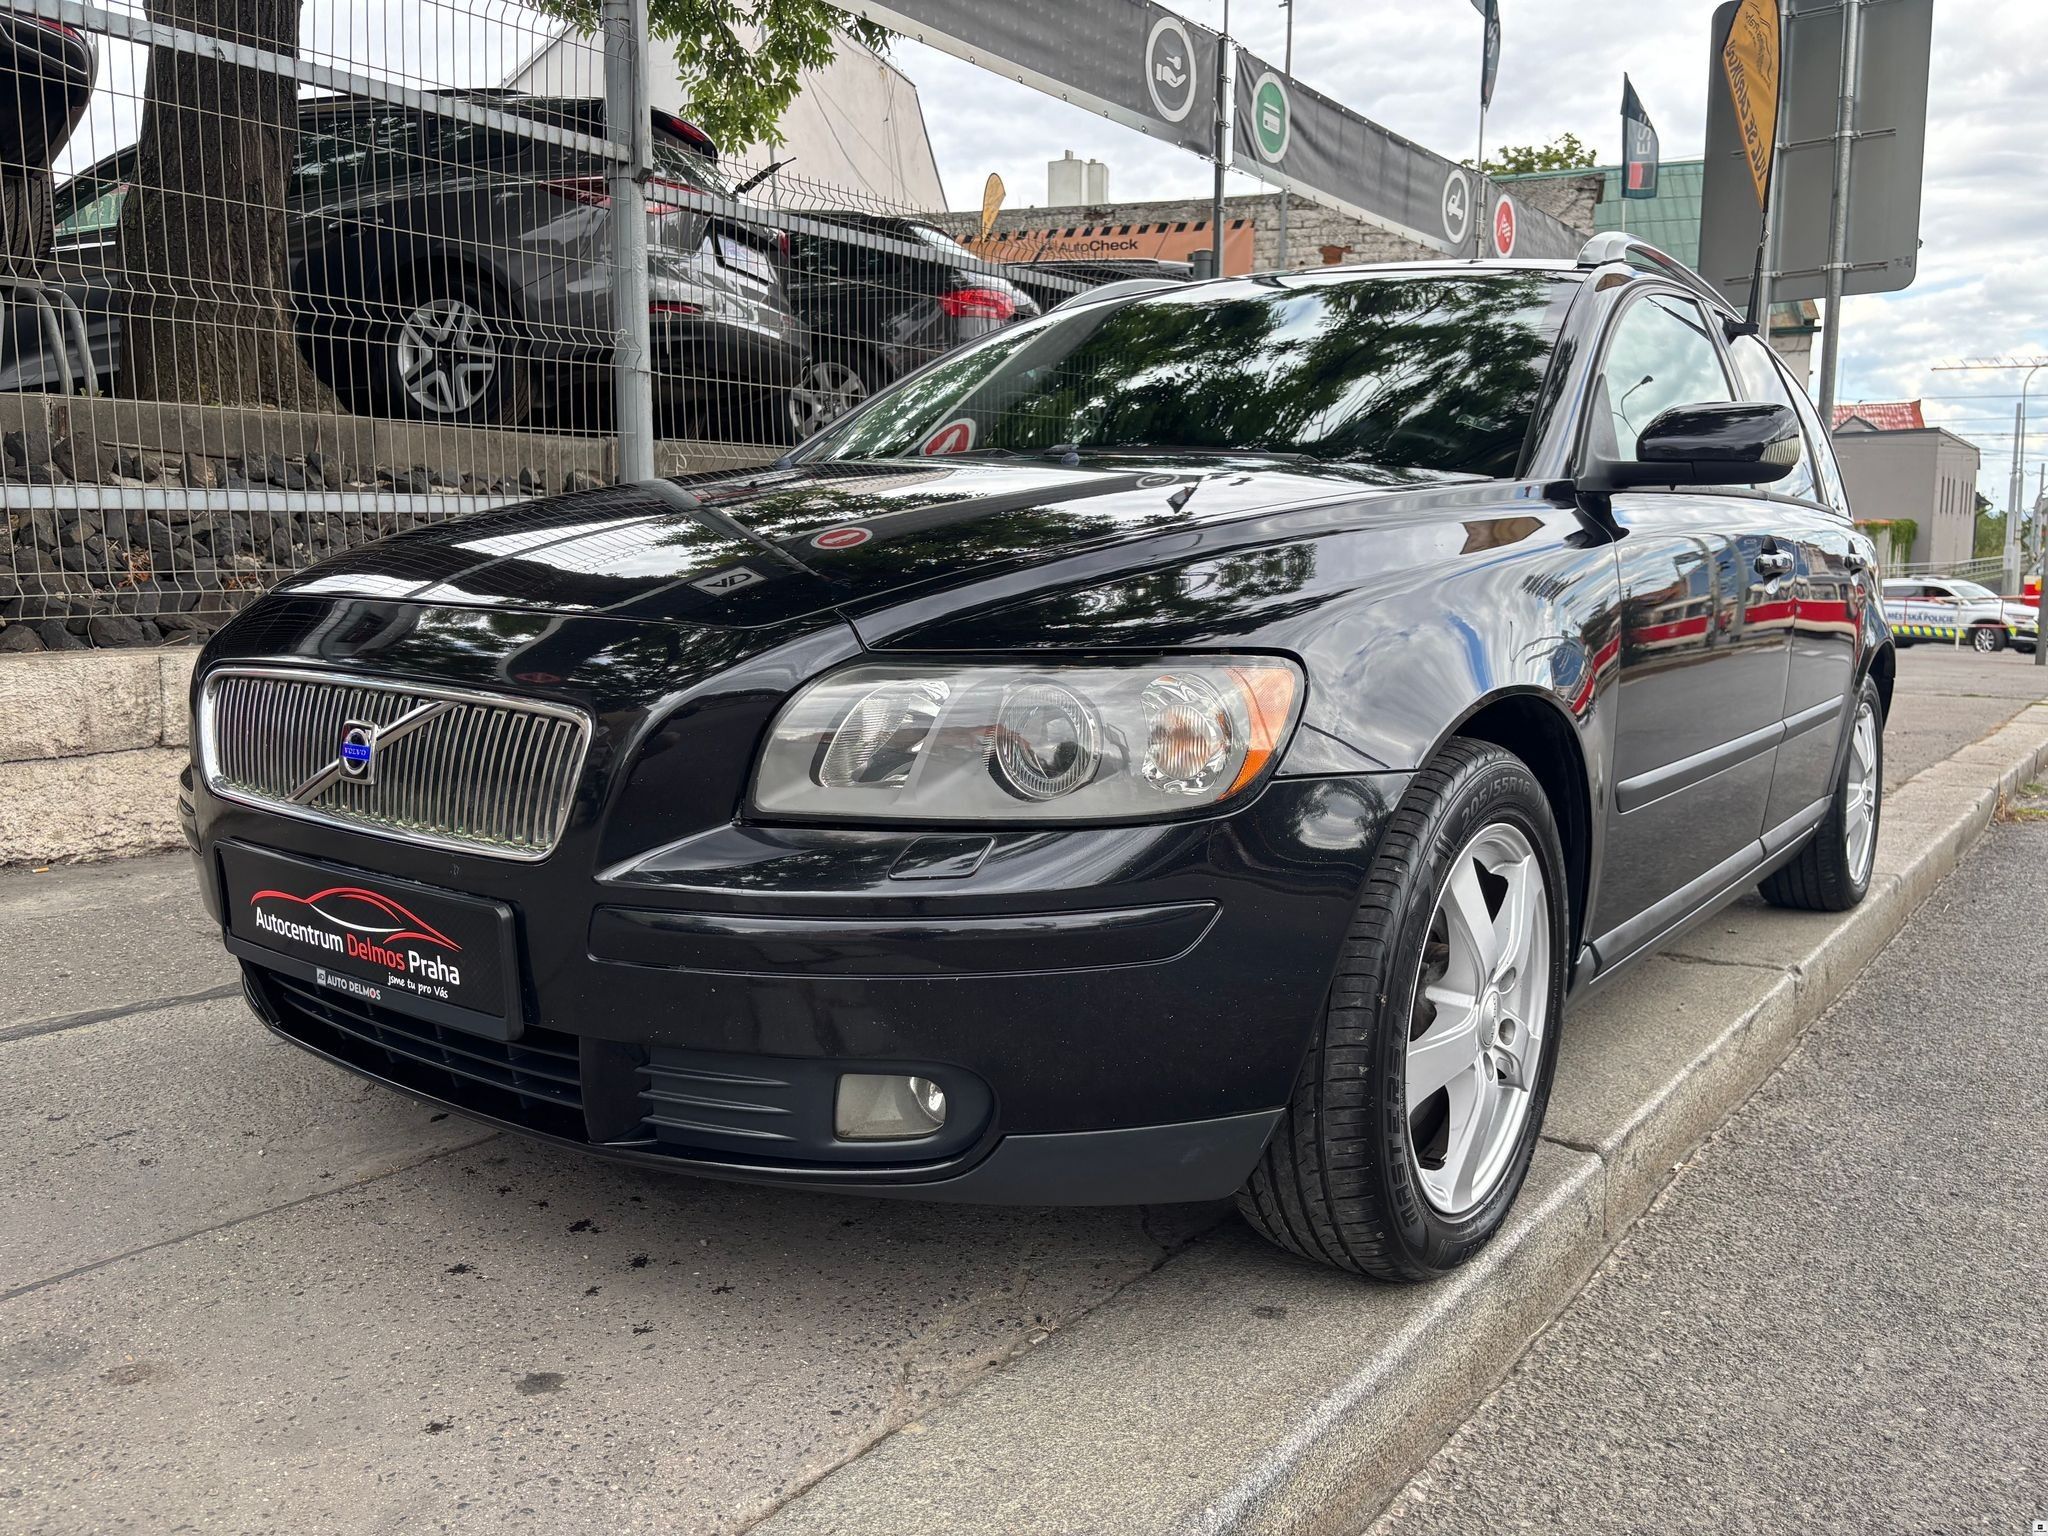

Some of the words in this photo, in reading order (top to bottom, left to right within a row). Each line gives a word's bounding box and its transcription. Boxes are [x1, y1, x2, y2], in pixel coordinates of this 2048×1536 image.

[1059, 238, 1138, 252] AutoCheck
[1888, 610, 1923, 621] MĚSSKÁ
[1924, 613, 1953, 623] POLICIE
[344, 747, 367, 756] VOLVO
[1461, 776, 1531, 830] 205/55R16
[256, 907, 344, 953] Autocentrum
[347, 934, 406, 971] Delmos
[408, 950, 460, 985] Praha
[327, 974, 348, 990] AUTO
[349, 980, 381, 1000] DELMOS
[387, 972, 405, 987] jsme
[407, 979, 416, 990] tu
[418, 983, 432, 995] pro
[433, 986, 449, 999] Vás
